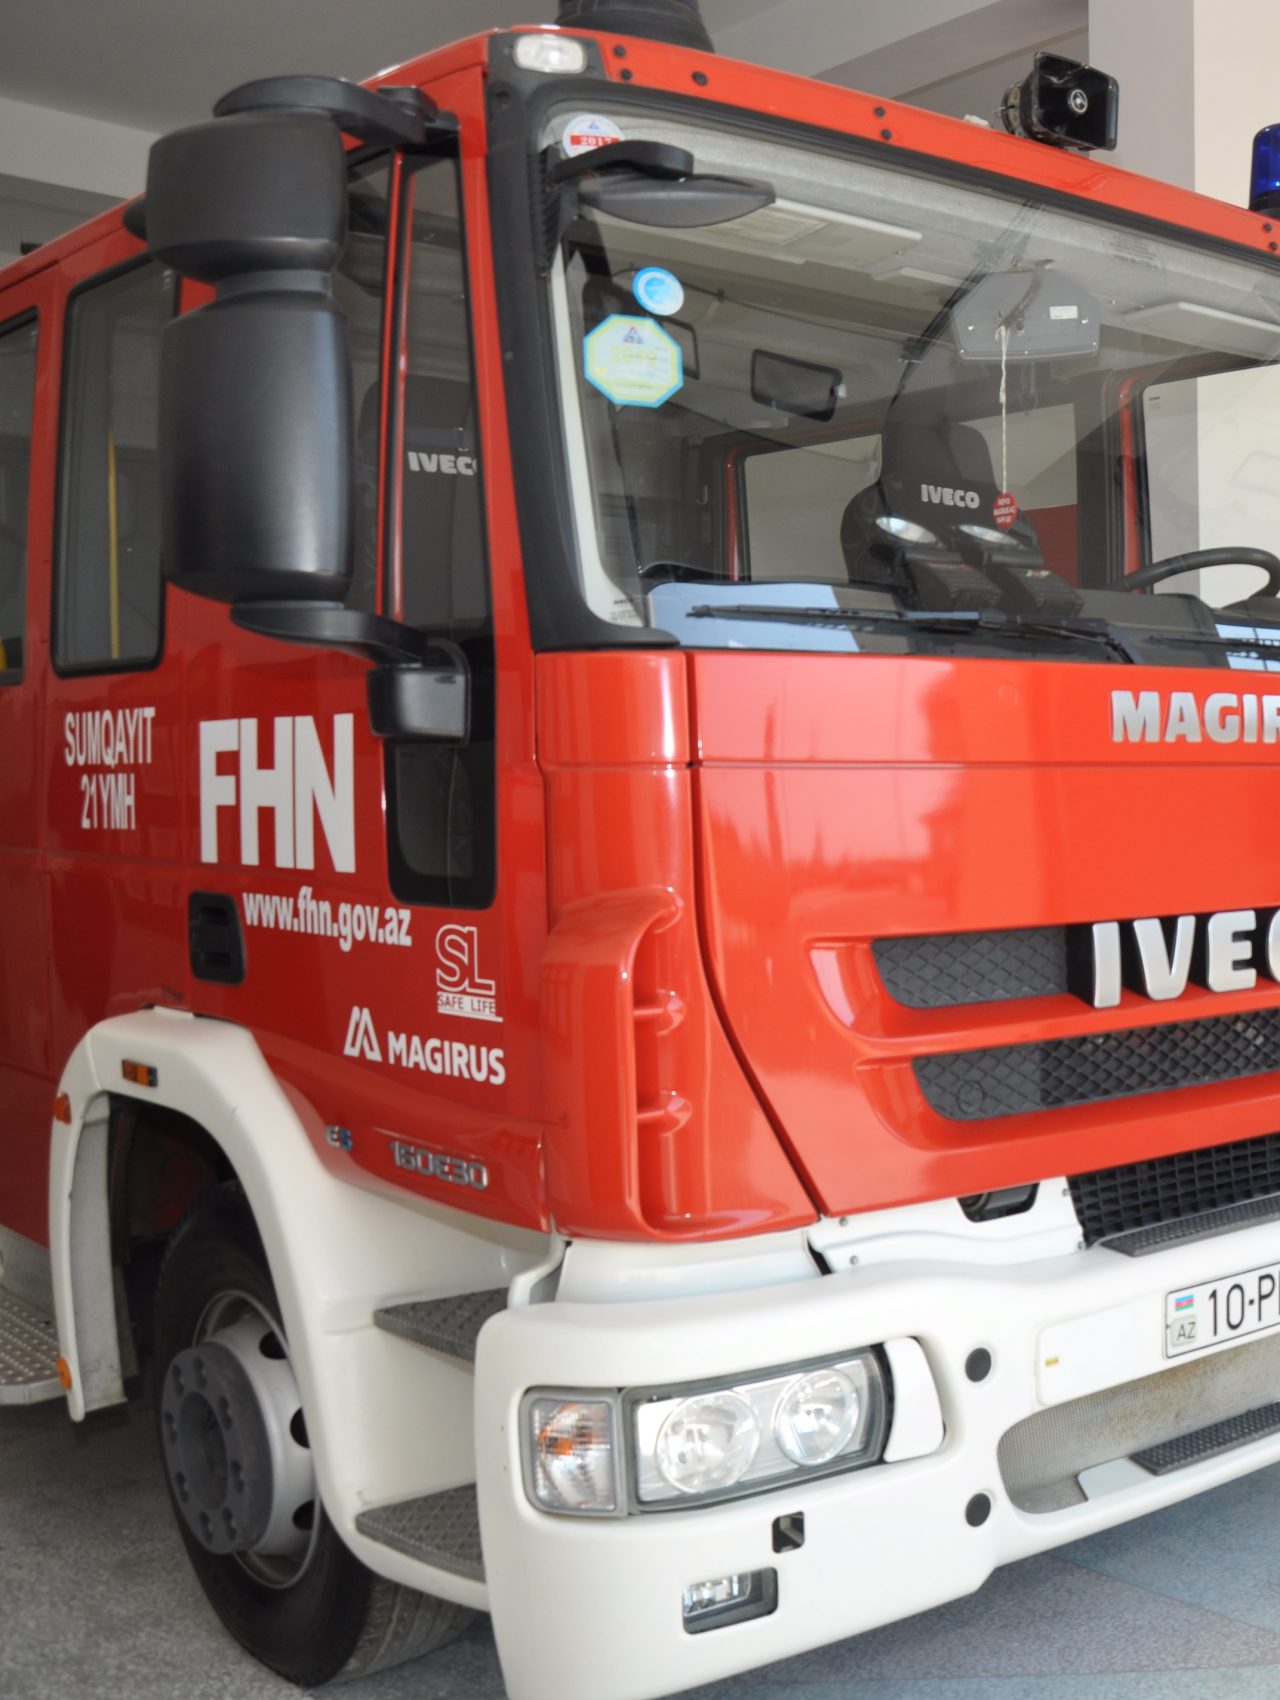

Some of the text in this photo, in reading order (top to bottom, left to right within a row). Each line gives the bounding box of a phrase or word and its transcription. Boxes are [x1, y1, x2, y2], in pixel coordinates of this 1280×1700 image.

[920, 484, 980, 509] IVECO
[65, 706, 155, 768] SUMQAYIT
[200, 713, 356, 873] FHN
[242, 886, 412, 952] www.fhn.gov.az
[437, 993, 496, 1015] SAFE LIFE
[388, 1033, 506, 1085] MAGIRUS
[1176, 1321, 1196, 1341] AZ
